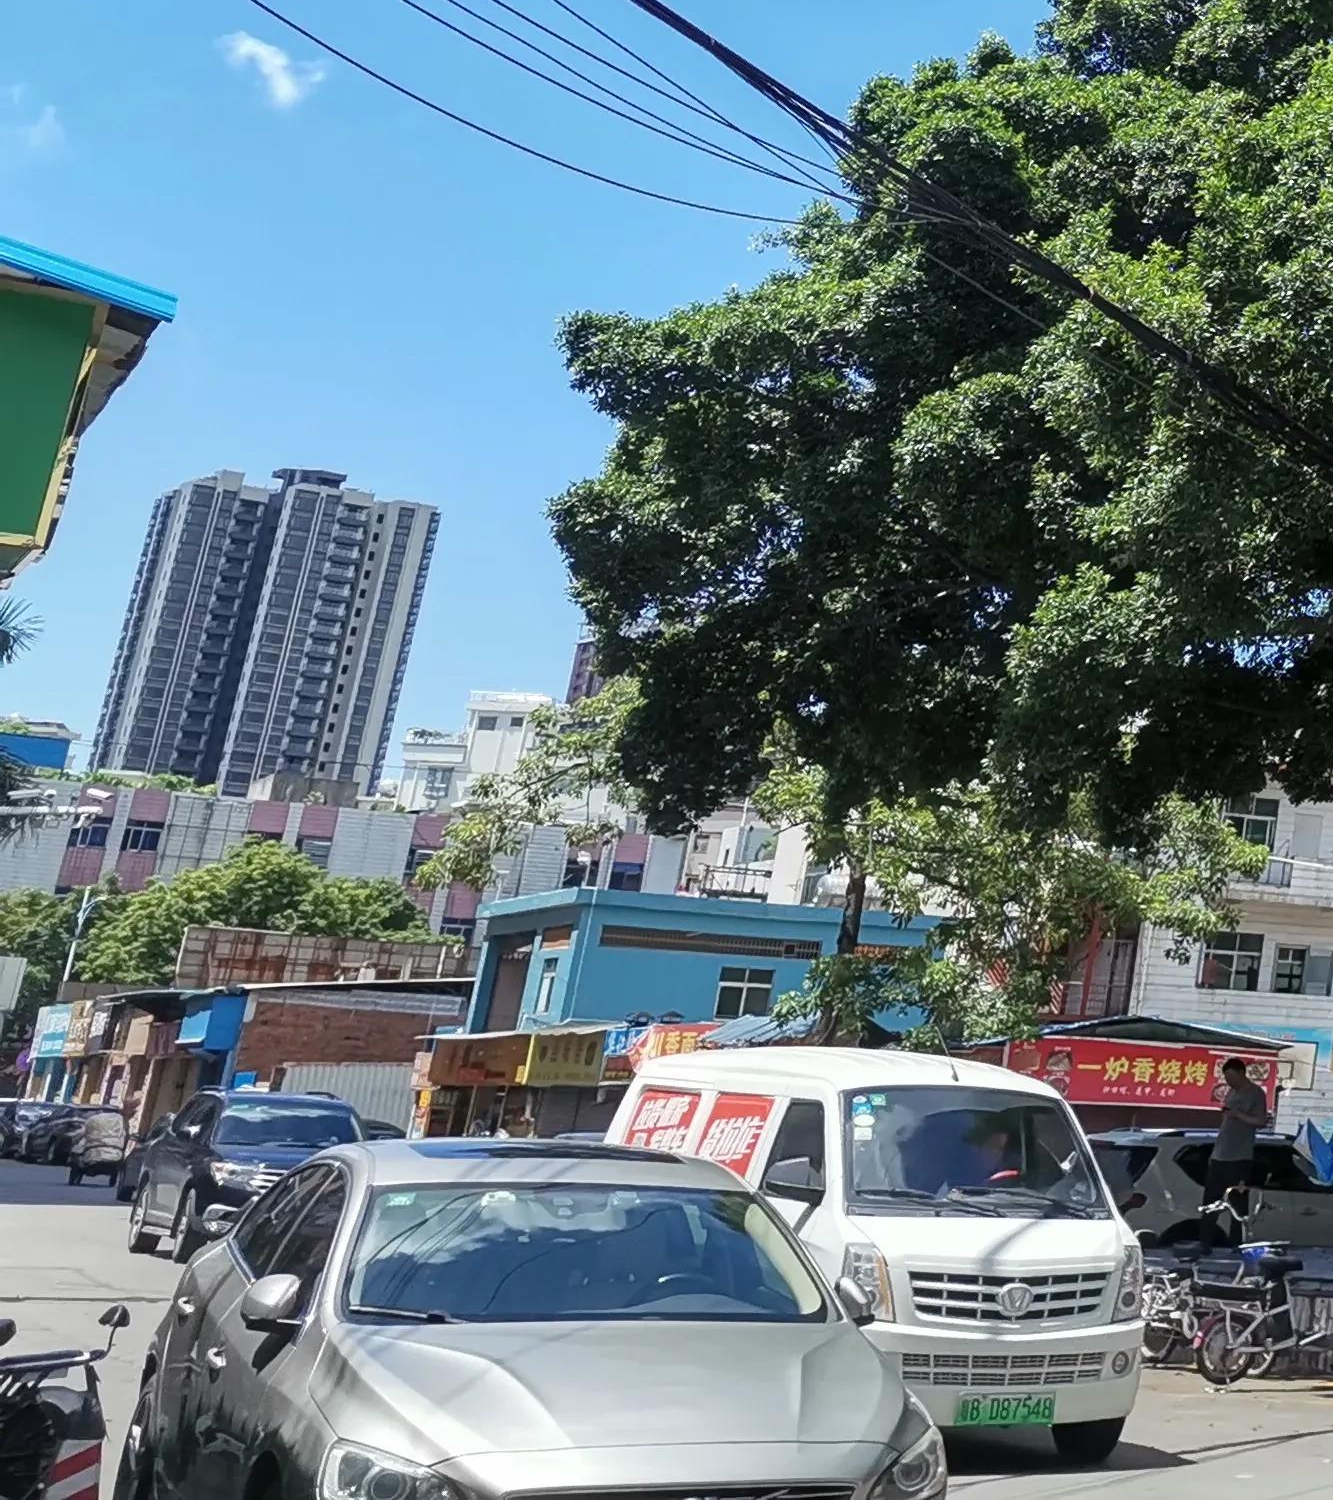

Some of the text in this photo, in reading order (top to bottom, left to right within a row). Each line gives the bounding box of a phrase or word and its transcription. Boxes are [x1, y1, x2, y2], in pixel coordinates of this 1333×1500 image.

[1077, 1055, 1209, 1087] 一炉香烧烤
